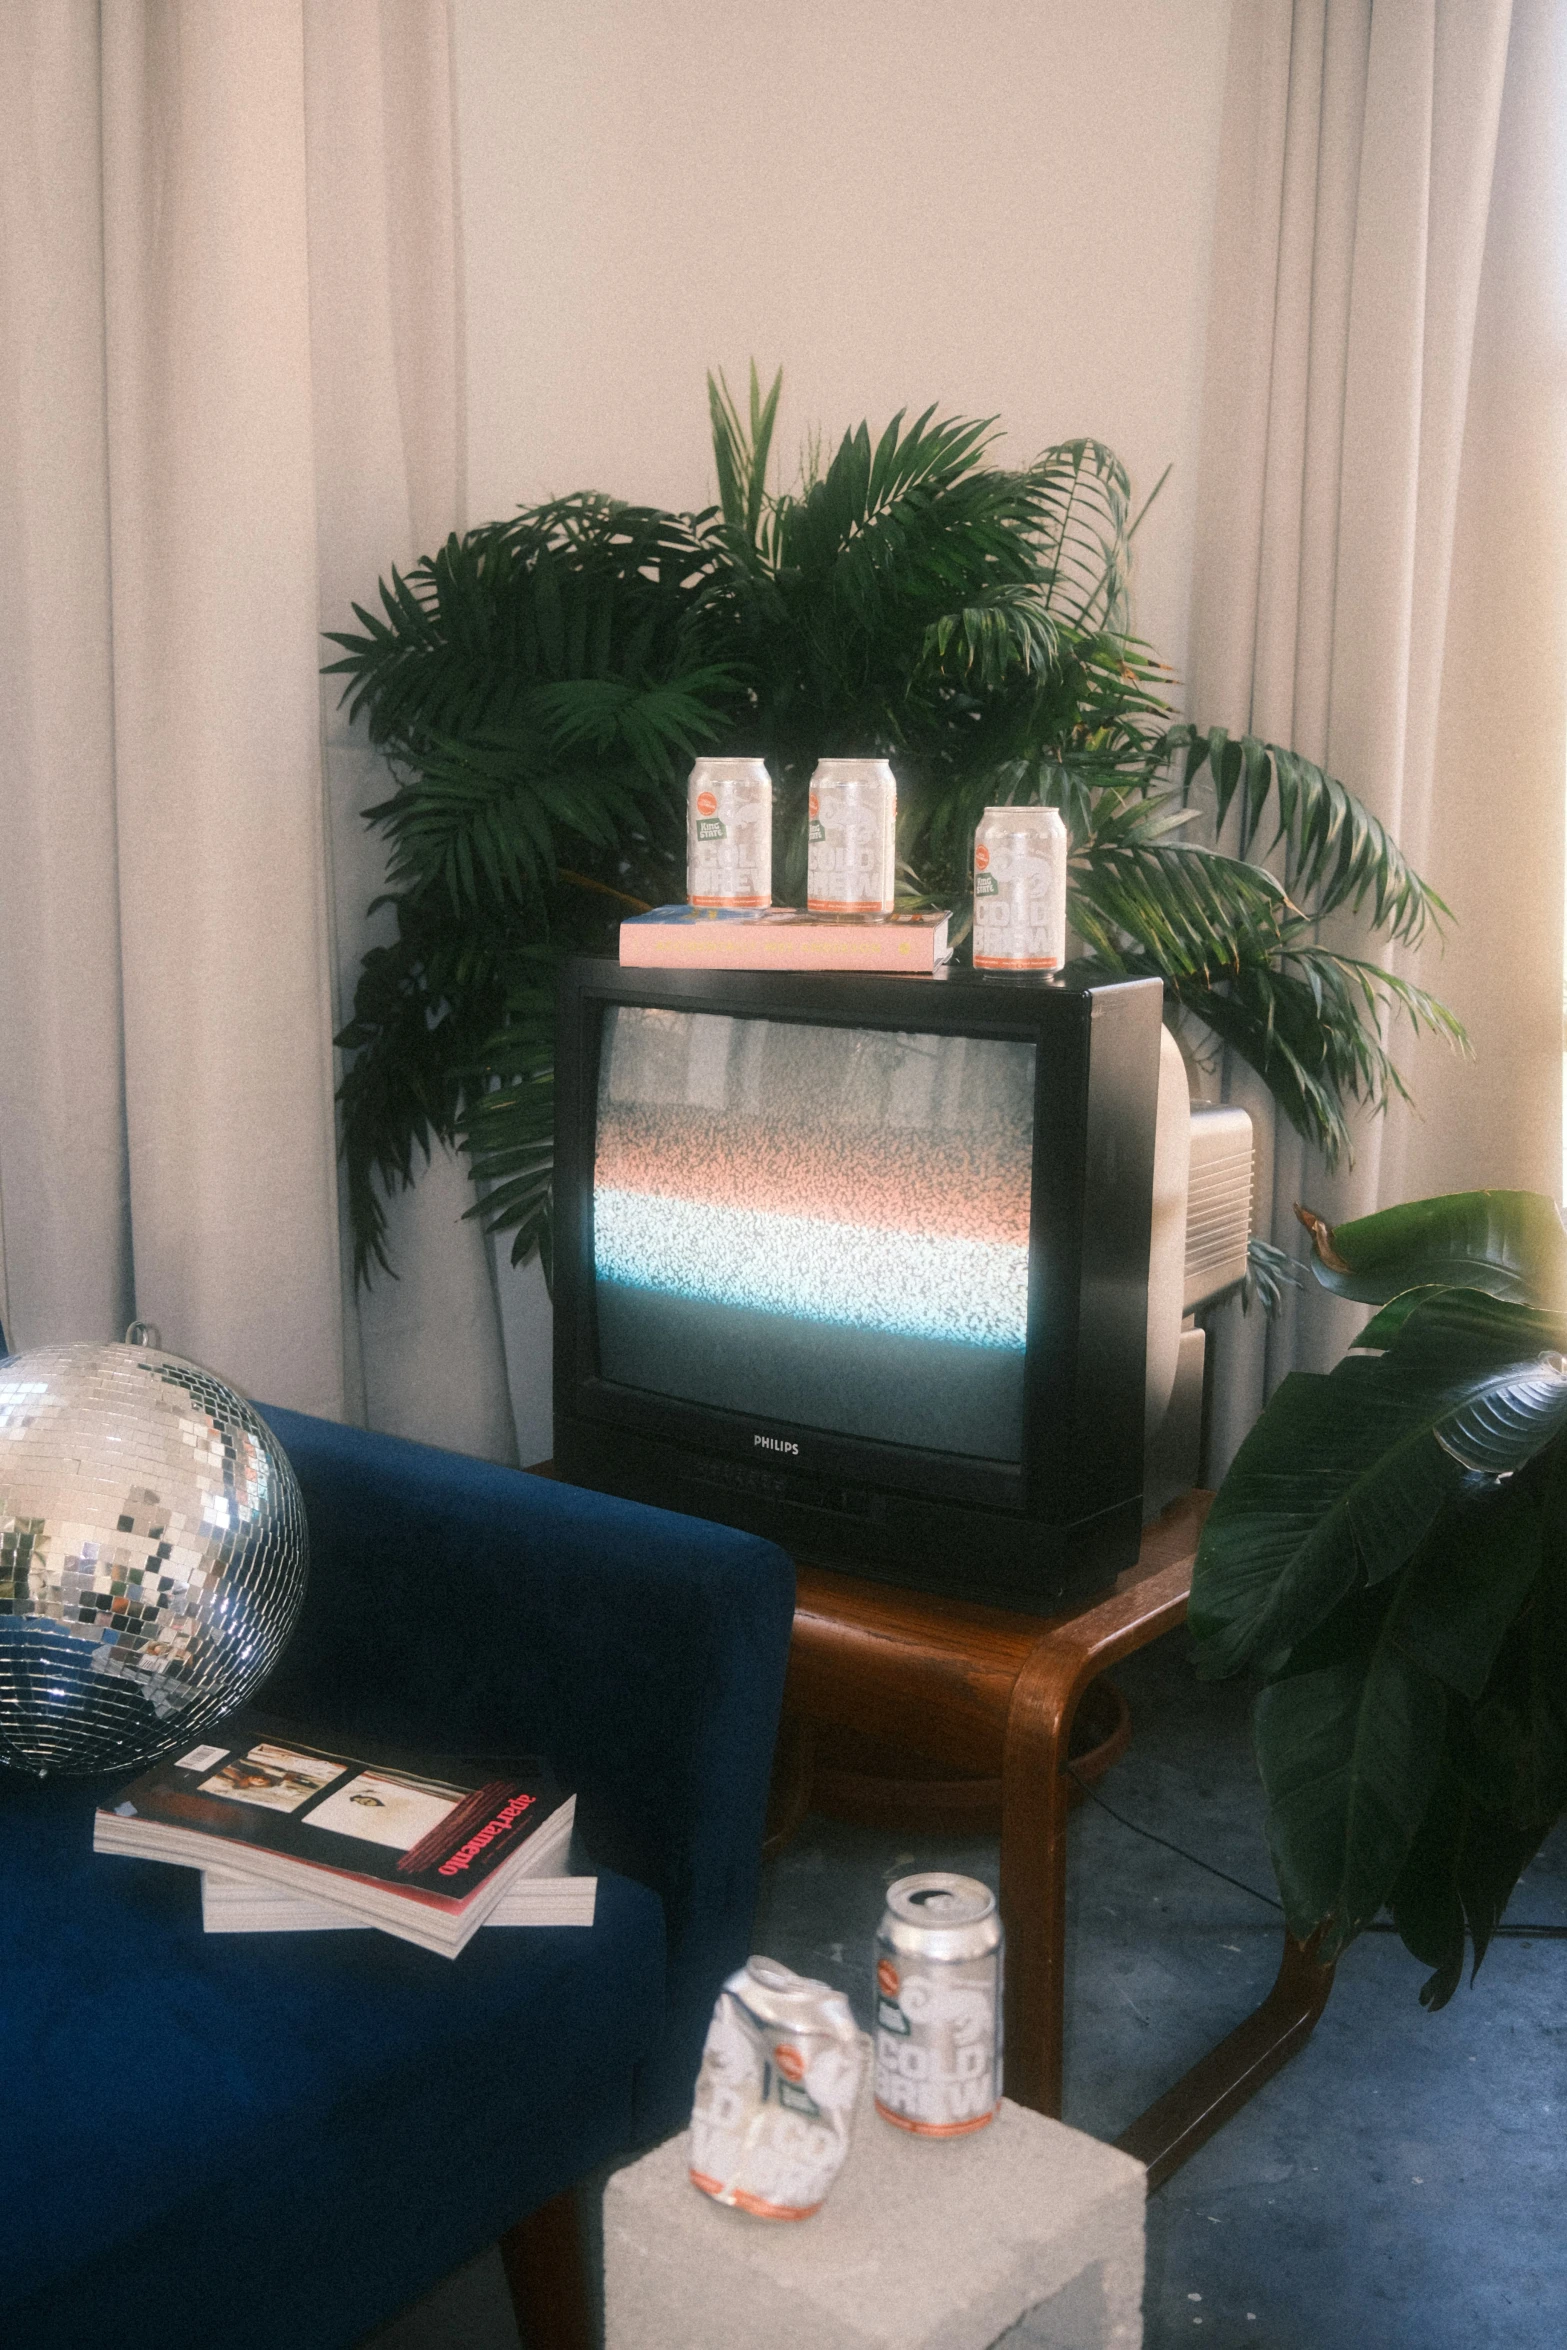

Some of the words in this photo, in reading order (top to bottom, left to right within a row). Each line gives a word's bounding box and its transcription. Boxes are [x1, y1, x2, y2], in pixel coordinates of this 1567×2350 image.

[699, 830, 723, 838] STATE
[754, 1434, 799, 1455] PHILIPS
[438, 1794, 536, 1875] apartamento
[877, 2034, 986, 2081] COLD
